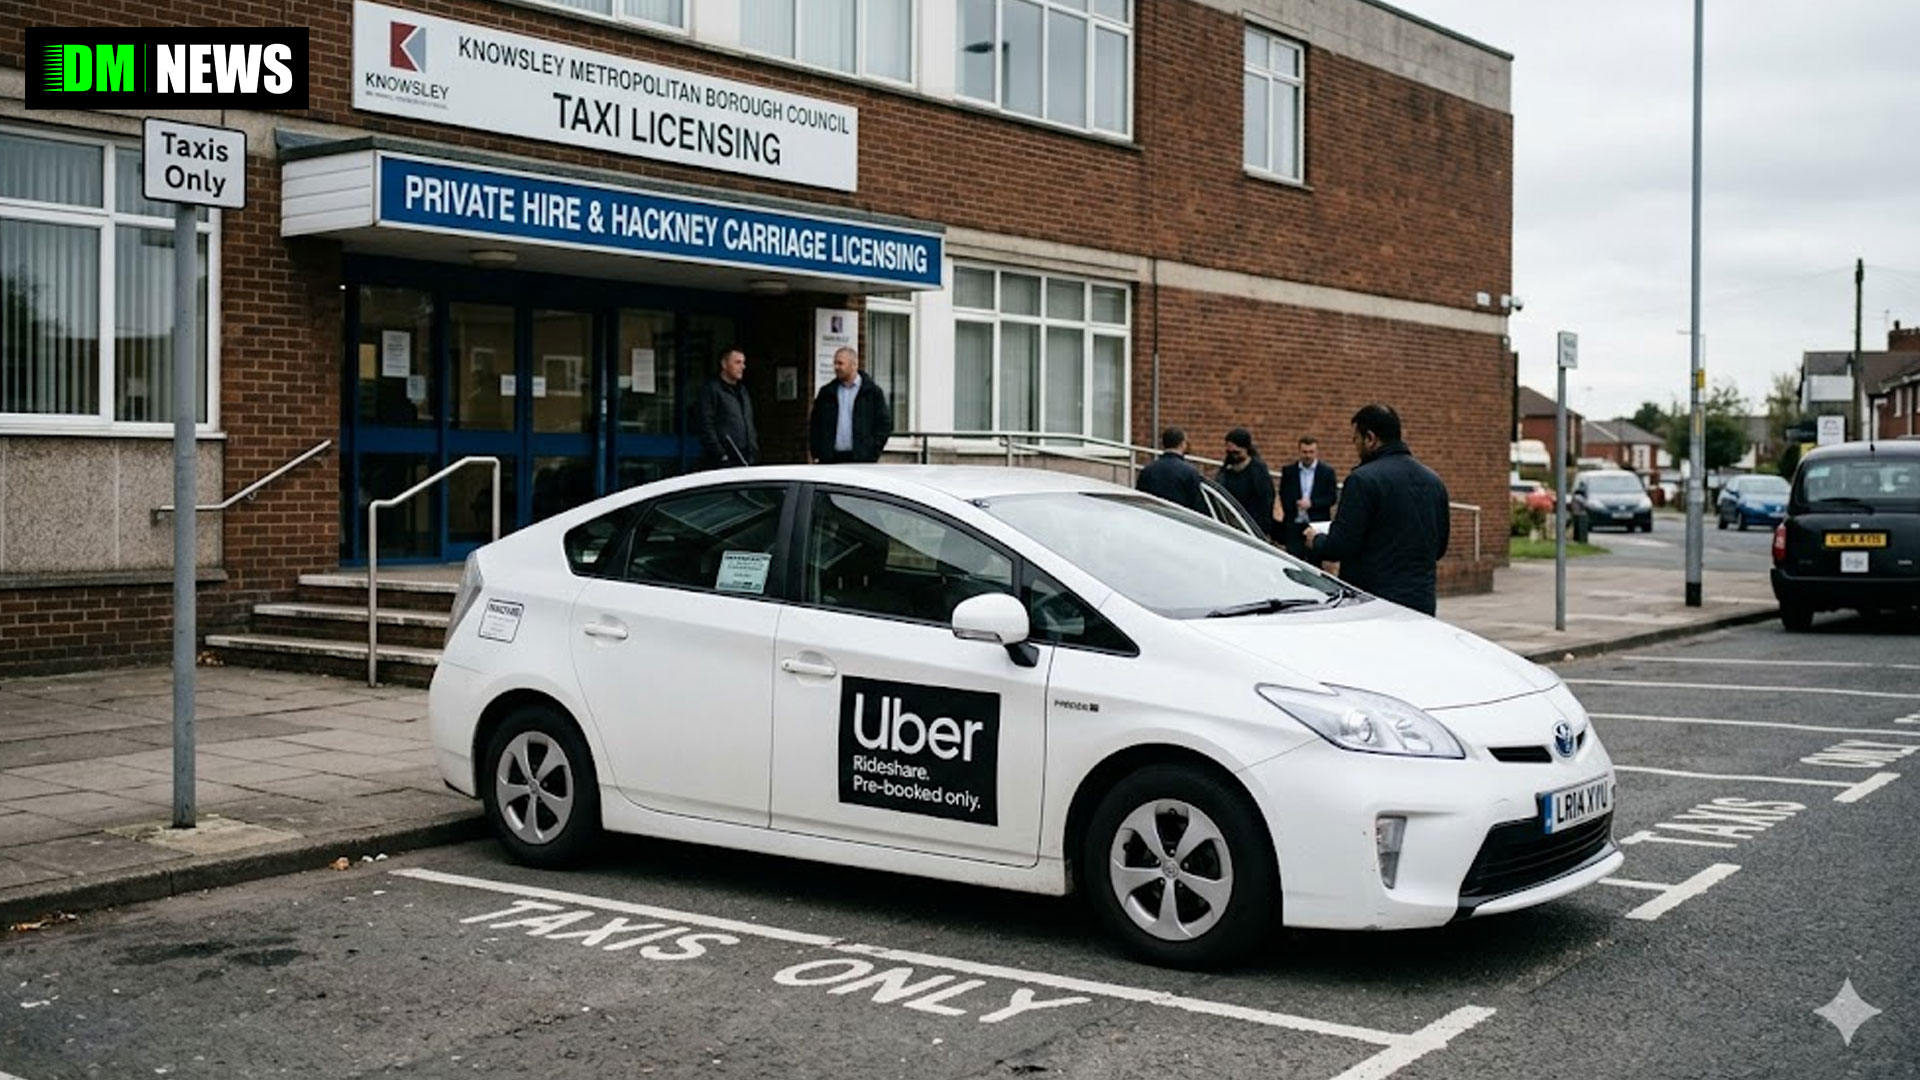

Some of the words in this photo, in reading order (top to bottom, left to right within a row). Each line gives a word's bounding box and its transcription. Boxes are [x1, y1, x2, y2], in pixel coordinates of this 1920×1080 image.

[365, 72, 449, 101] KNOWSLEY
[459, 36, 565, 76] KNOWSLEY
[570, 59, 700, 104] METROPOLITAN
[706, 88, 783, 121] BOROUGH
[787, 105, 850, 135] COUNCIL
[161, 131, 229, 162] Taxis
[553, 92, 620, 138] TAXI
[632, 107, 781, 166] LICENSING
[165, 165, 226, 197] Only
[405, 175, 516, 222] PRIVATE
[523, 190, 582, 231] HIRE
[588, 200, 605, 234] &
[611, 203, 718, 247] HACKNEY
[723, 218, 828, 261] CARRIAGE
[832, 233, 928, 274] LICENSING
[853, 693, 984, 762] Uber
[853, 754, 930, 781] Rideshare.
[853, 774, 943, 804] Pre-booked
[945, 788, 981, 812] only.
[1618, 797, 1807, 848] TAXIS
[459, 900, 740, 962] TAXIS
[772, 958, 1092, 1023] ONLY
